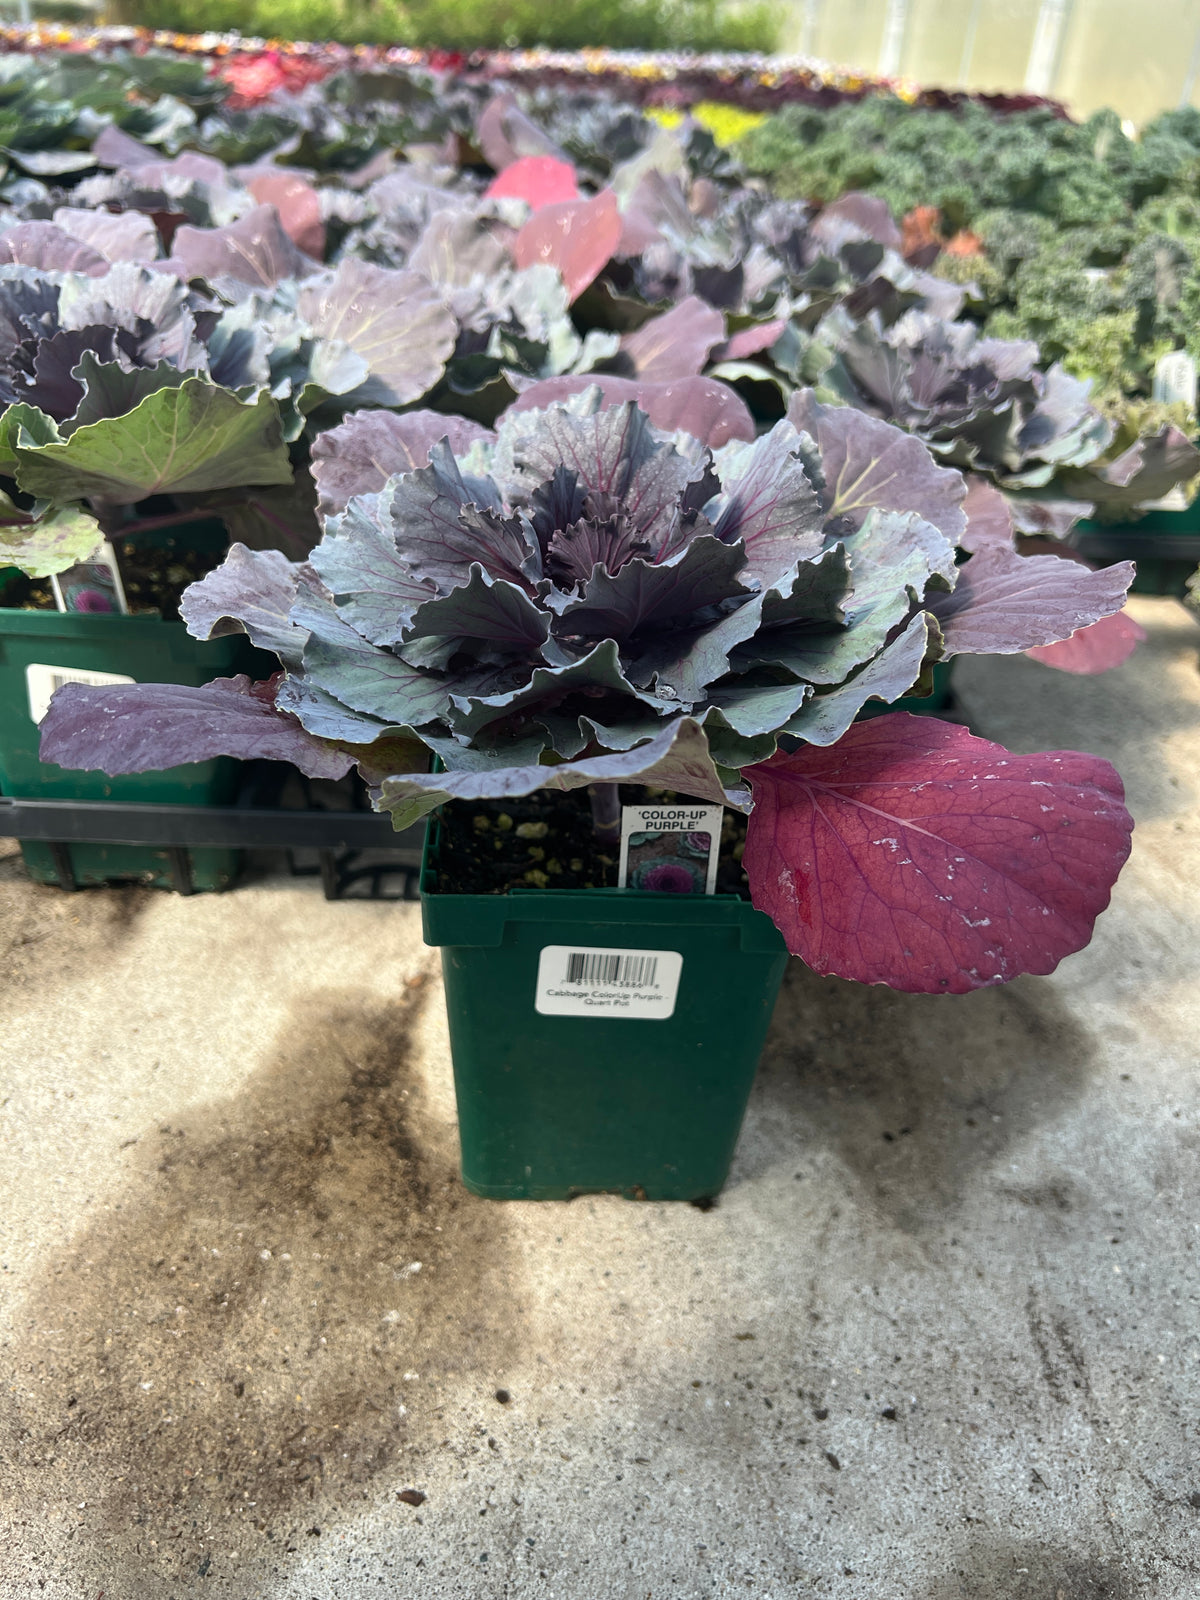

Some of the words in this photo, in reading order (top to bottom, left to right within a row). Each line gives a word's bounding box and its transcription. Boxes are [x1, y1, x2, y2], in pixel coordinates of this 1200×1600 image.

[638, 810, 707, 820] 'COLOR-UP
[645, 821, 699, 830] PURPLE'
[546, 989, 589, 999] Cabbage
[633, 992, 664, 1001] Purple
[584, 998, 611, 1006] Quart
